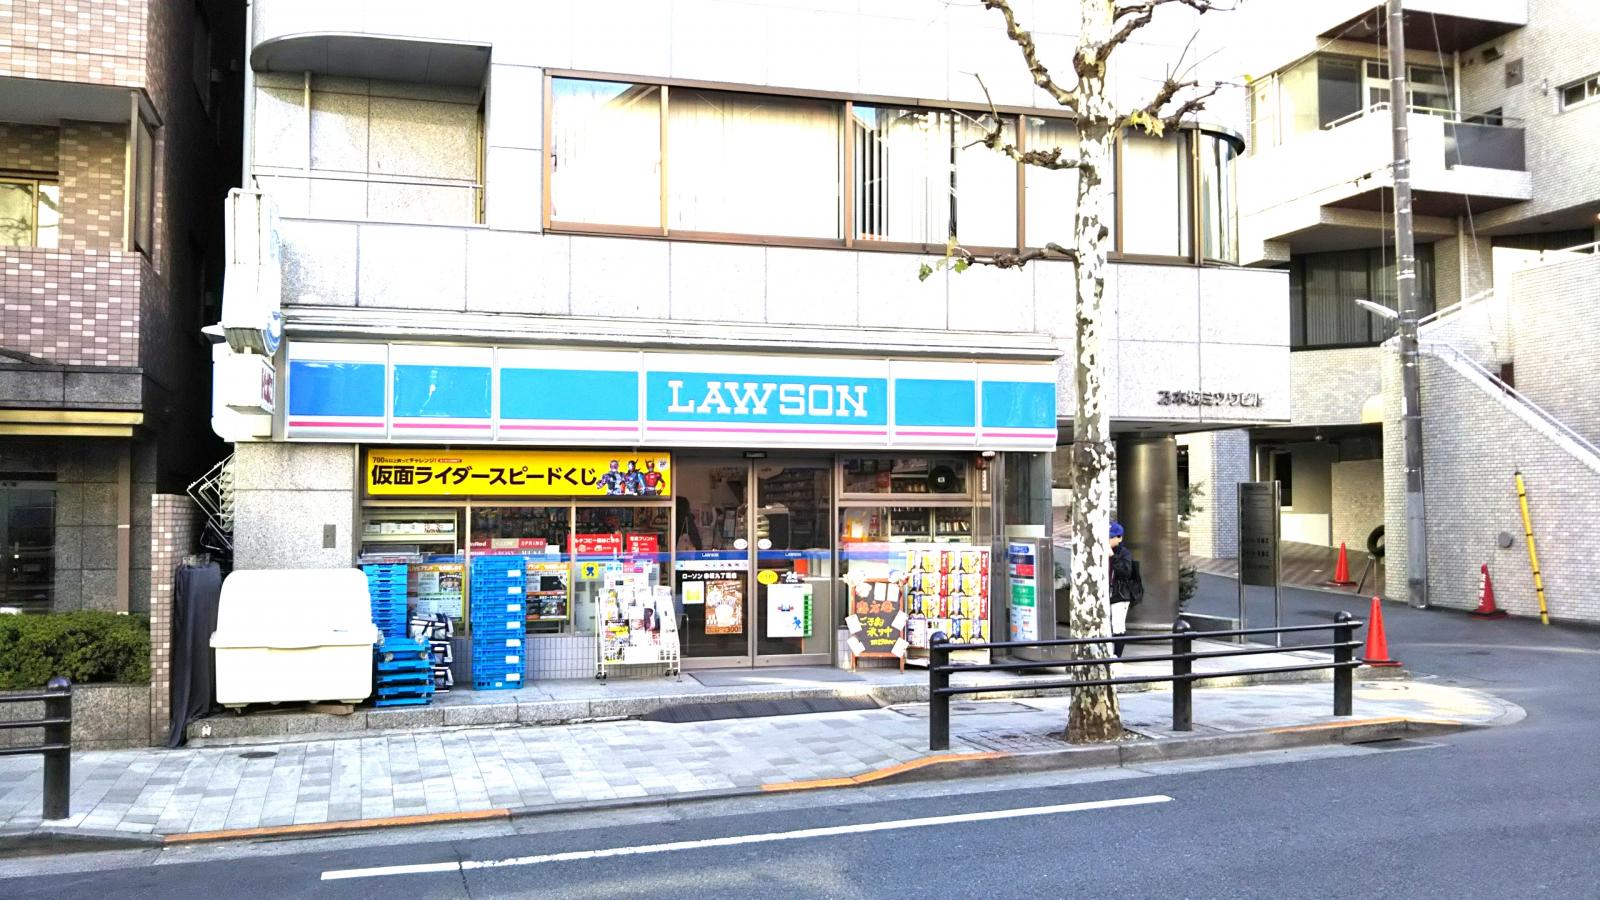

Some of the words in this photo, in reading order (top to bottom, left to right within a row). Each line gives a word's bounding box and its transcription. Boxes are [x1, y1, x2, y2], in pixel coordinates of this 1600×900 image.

[667, 379, 868, 417] LAWSON
[371, 465, 597, 486] 仮面ライダースピードくじ
